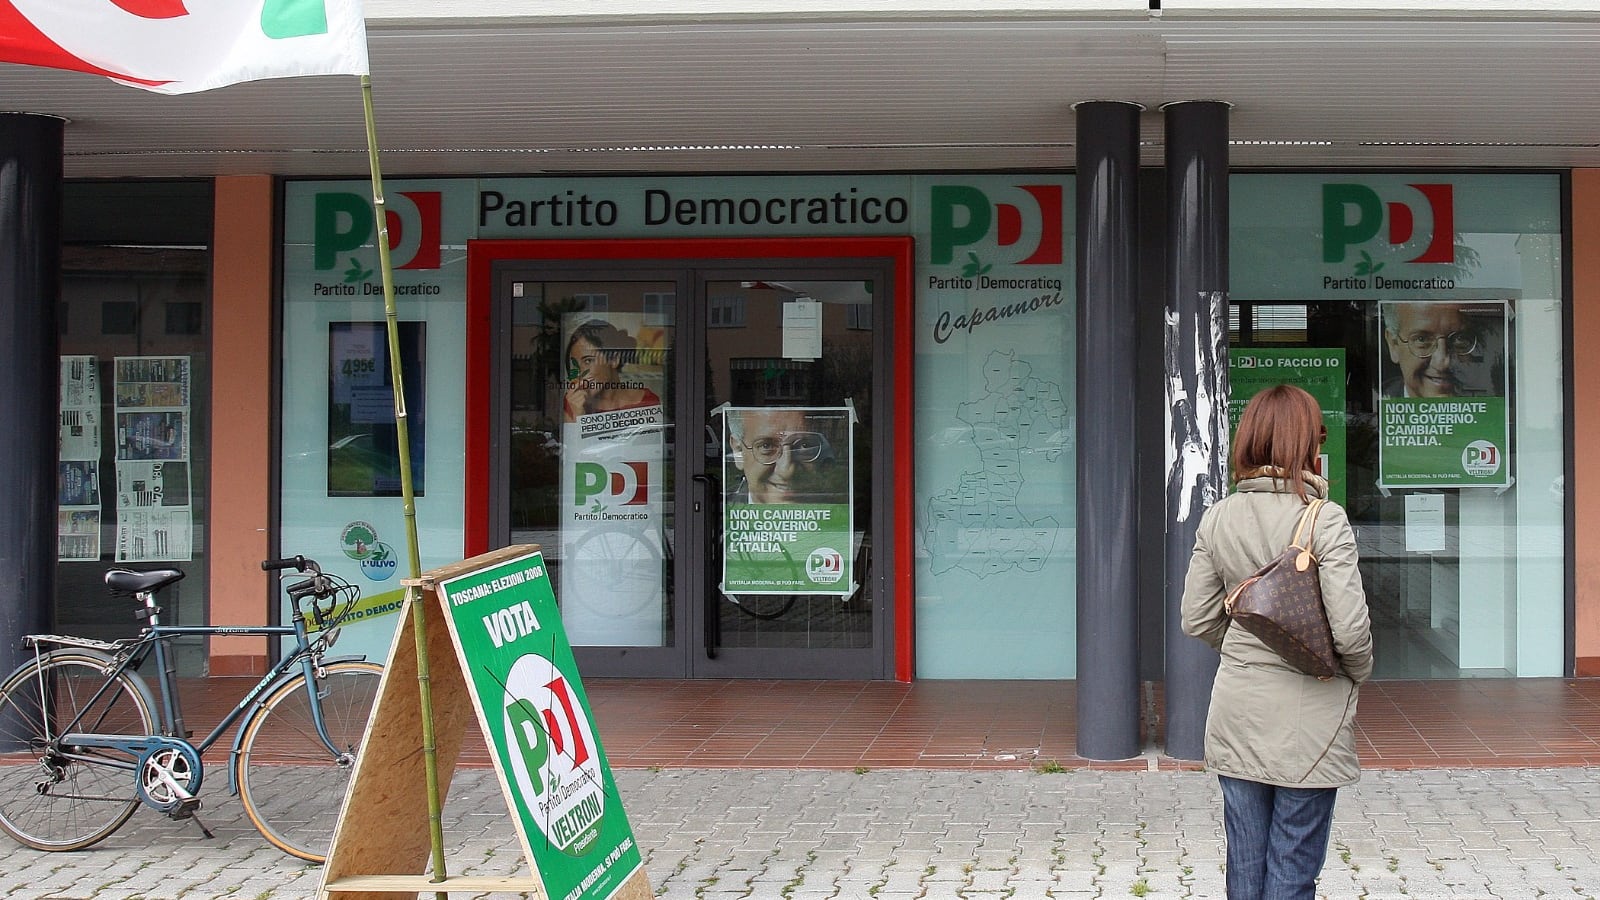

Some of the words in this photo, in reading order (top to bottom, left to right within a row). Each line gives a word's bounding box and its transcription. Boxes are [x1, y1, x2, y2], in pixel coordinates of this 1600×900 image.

[479, 189, 618, 227] Partito
[644, 187, 909, 226] Democratico
[930, 184, 1063, 265] PD
[1322, 183, 1454, 263] PD
[314, 282, 355, 296] Partito
[929, 275, 972, 290] Partito
[980, 275, 1062, 290] Democratico
[1323, 276, 1367, 290] Partito
[1375, 276, 1455, 290] Democratico
[933, 287, 1064, 344] Capannori
[1258, 358, 1273, 367] LO
[1277, 358, 1322, 367] FACCIO
[1326, 358, 1339, 367] IO
[582, 378, 645, 390] Democratico
[1386, 403, 1415, 413] NON
[1419, 403, 1487, 413] CAMBIATE
[580, 415, 604, 425] SONO
[612, 417, 645, 429] DECIDO
[1386, 414, 1405, 424] UN
[1409, 414, 1477, 424] GOVERNO.
[1386, 425, 1453, 435] CAMBIATE
[1386, 436, 1442, 446] L'ITALIA.
[1466, 447, 1496, 464] PD
[574, 462, 648, 506] PD
[574, 512, 599, 521] Partito
[602, 512, 648, 521] Democratico
[729, 510, 759, 520] NON
[763, 510, 831, 520] CAMBIATE
[730, 521, 749, 531] UN
[753, 521, 821, 531] GOVERNO.
[730, 532, 797, 542] CAMBIATE
[730, 542, 785, 553] L'ITALIA.
[362, 560, 396, 568] L'ULIVO
[811, 554, 840, 571] PD
[450, 583, 493, 607] TOSCANA:
[491, 571, 525, 593] ELEZIONI
[524, 565, 543, 581] 2008
[366, 600, 404, 617] DEMOC
[482, 600, 541, 649] VOTA
[506, 676, 590, 797] PD
[538, 792, 561, 818] Partito
[551, 791, 602, 847] VELTRONI
